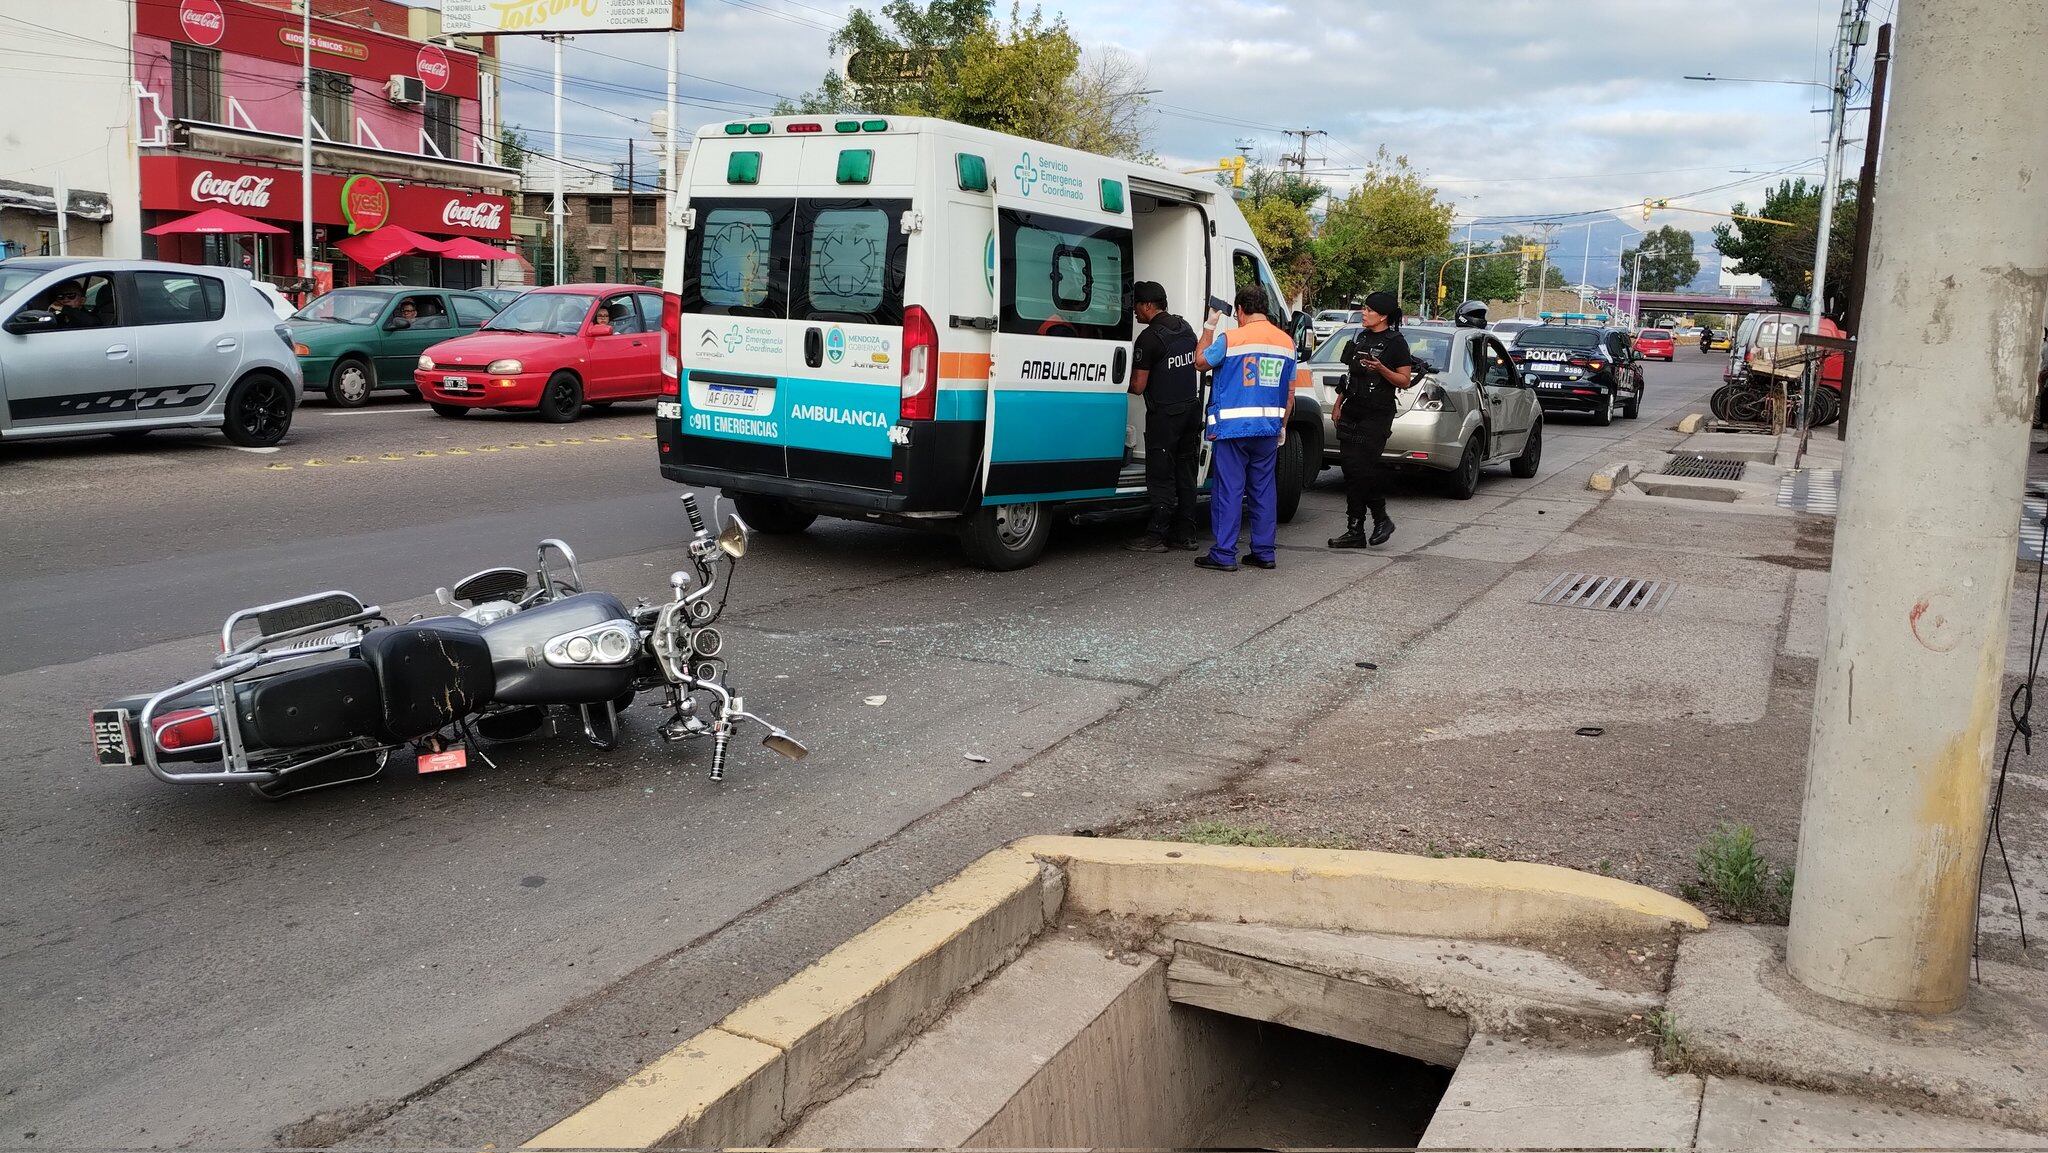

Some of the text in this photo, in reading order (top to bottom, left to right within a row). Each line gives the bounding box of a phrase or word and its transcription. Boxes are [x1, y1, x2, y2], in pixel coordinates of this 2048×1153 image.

[182, 9, 222, 30] Coca-Cola
[610, 8, 636, 16] JUEGOS
[646, 7, 670, 15] JARDIN
[418, 59, 447, 77] Coca-Cola
[1038, 156, 1069, 172] Servicio
[1040, 169, 1083, 188] Emergencia
[190, 170, 274, 208] Coca-Cola
[1042, 183, 1084, 201] Coordinado
[351, 192, 383, 215] yes!
[442, 199, 504, 230] Coca-Cola
[745, 326, 772, 335] Servicio
[848, 335, 880, 343] MENDOZA
[745, 335, 784, 346] Emergencia
[745, 343, 783, 354] Coordinado
[1525, 350, 1568, 362] POLICIA
[1021, 360, 1107, 382] AMBULANCIA
[1260, 359, 1283, 378] SEC
[708, 391, 754, 407] AF 093 UZ
[791, 404, 888, 429] AMBULANCIA
[695, 413, 778, 439] 911 EMERGENCIAS
[95, 721, 112, 755] HUK
